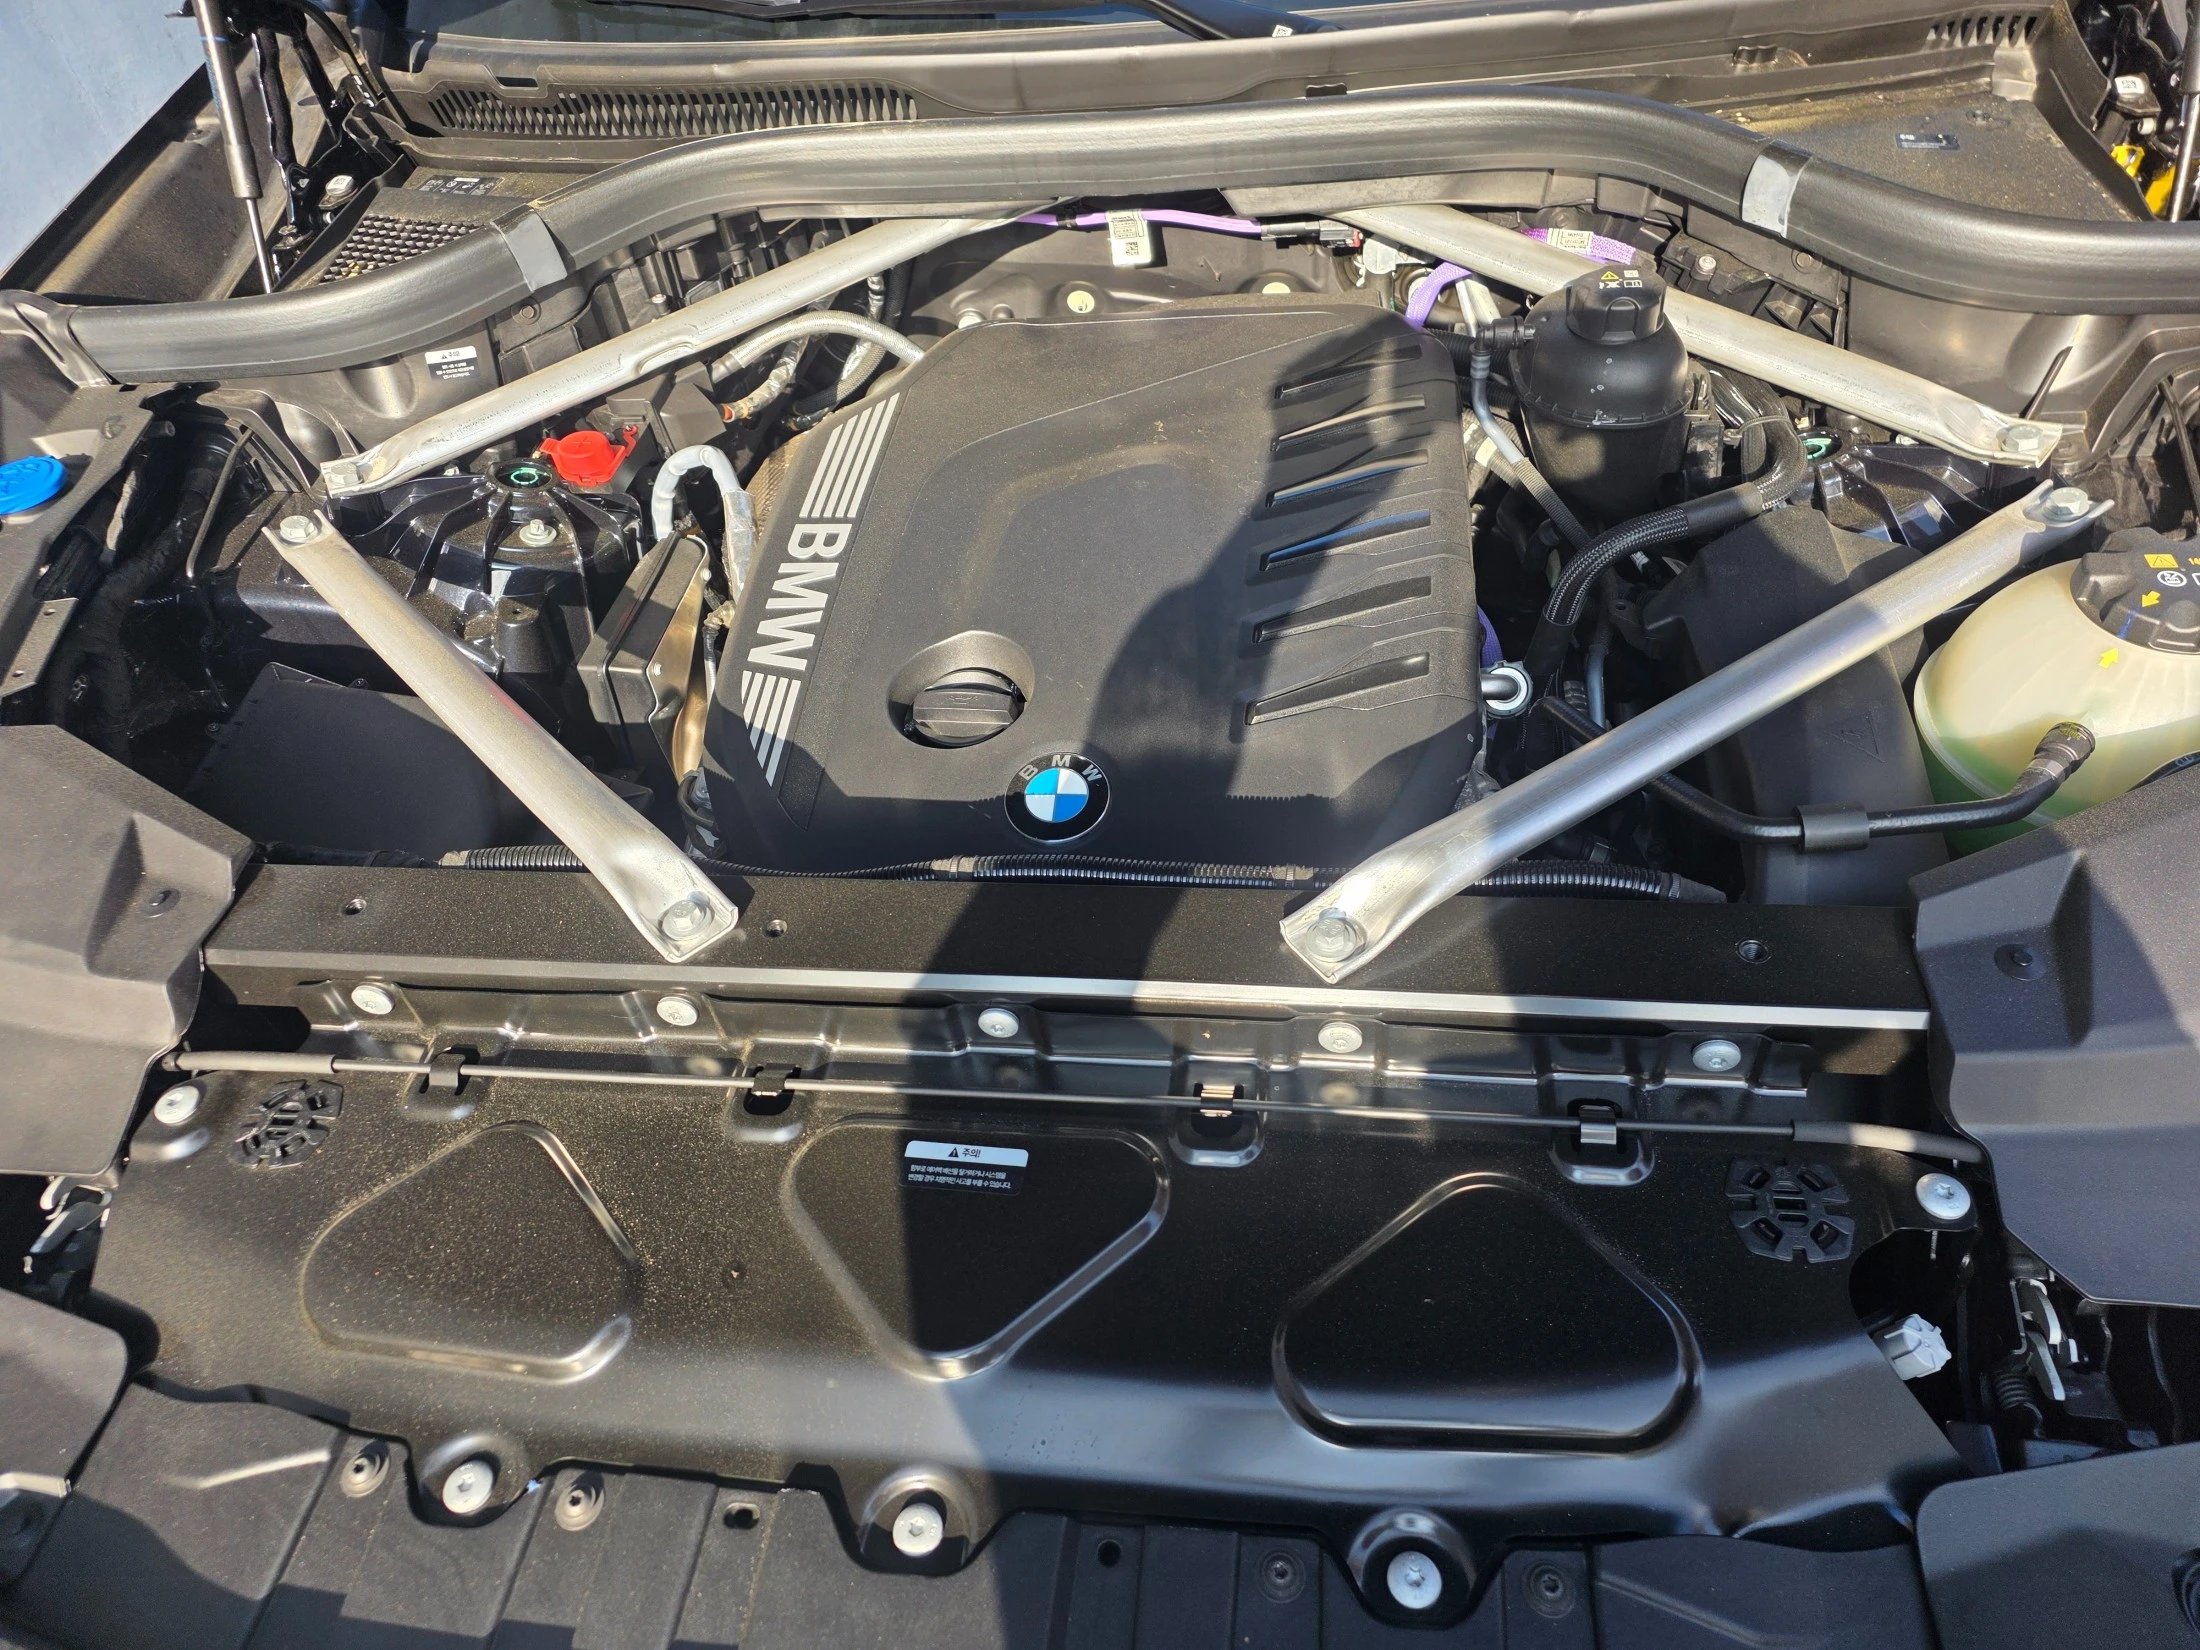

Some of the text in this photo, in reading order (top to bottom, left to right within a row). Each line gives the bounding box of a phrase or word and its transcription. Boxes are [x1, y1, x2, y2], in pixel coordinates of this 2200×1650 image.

[747, 523, 852, 671] BMW
[1018, 754, 1102, 782] BMW
[961, 1148, 981, 1158] 주의!
